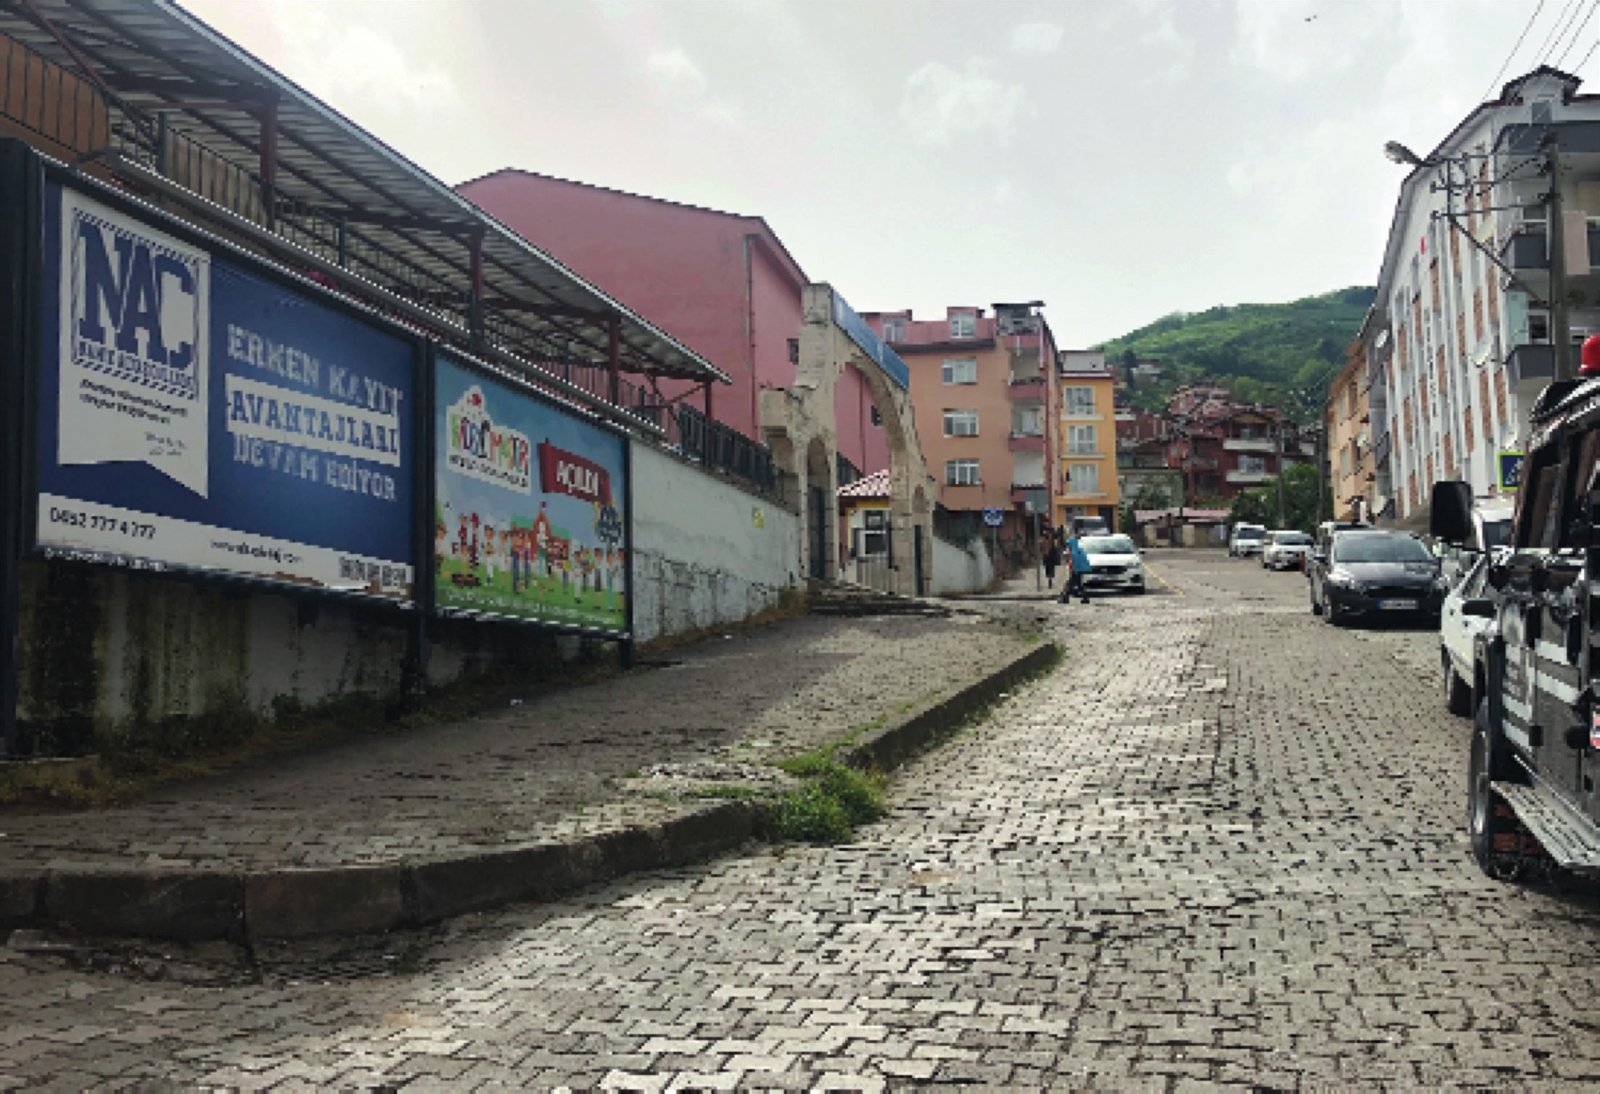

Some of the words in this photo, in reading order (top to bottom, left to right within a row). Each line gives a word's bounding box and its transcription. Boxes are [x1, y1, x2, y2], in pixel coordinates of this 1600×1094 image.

[79, 216, 194, 372] NAC
[227, 323, 320, 388] ERKEN
[329, 364, 403, 418] KAYIT
[230, 390, 398, 456] AVANTAJLARI
[233, 434, 319, 482] DEVAM
[326, 458, 397, 501] EDİYOR
[556, 460, 599, 497] AÇILDI
